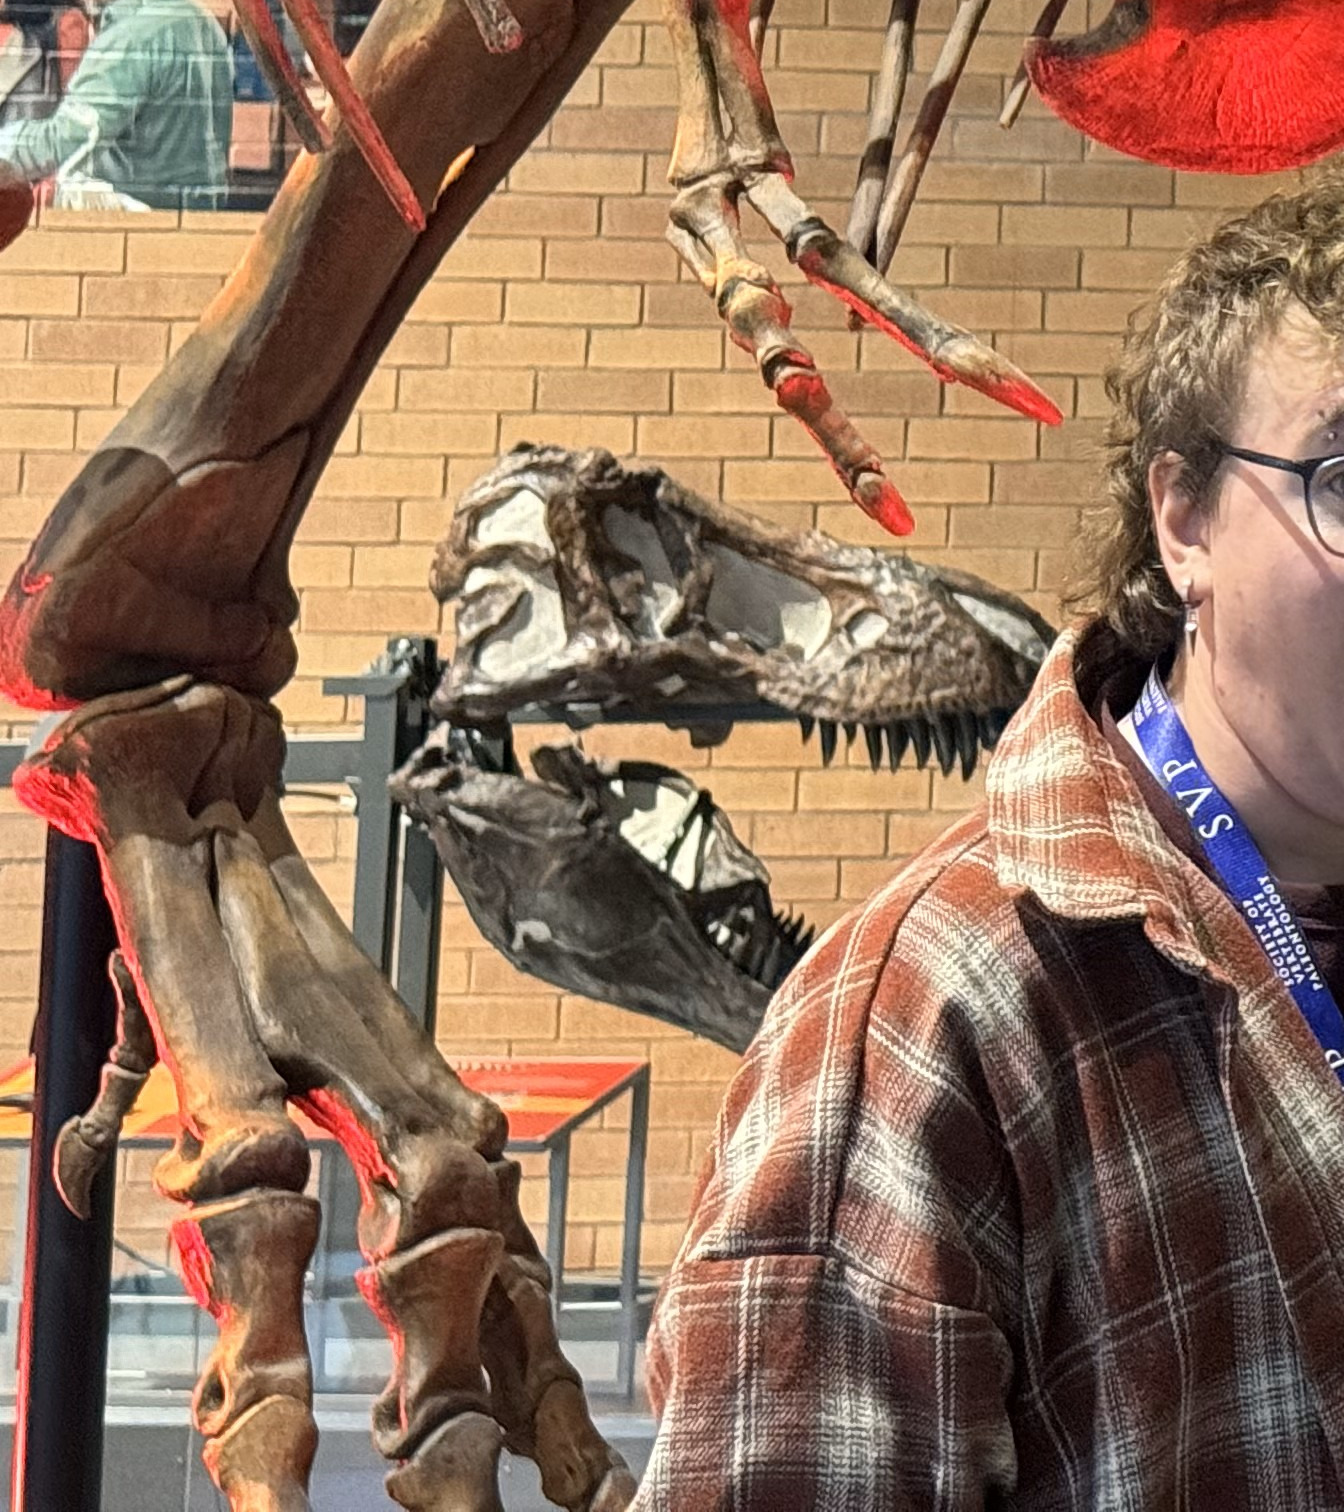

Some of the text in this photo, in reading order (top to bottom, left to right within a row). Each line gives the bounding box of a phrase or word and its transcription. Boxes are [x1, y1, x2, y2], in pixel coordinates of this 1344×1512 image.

[1162, 759, 1234, 839] SVP
[1242, 900, 1295, 987] SOCIETY OF
[1253, 893, 1305, 984] VERTEBRATE
[1257, 876, 1323, 991] PALEONTOLOGY
